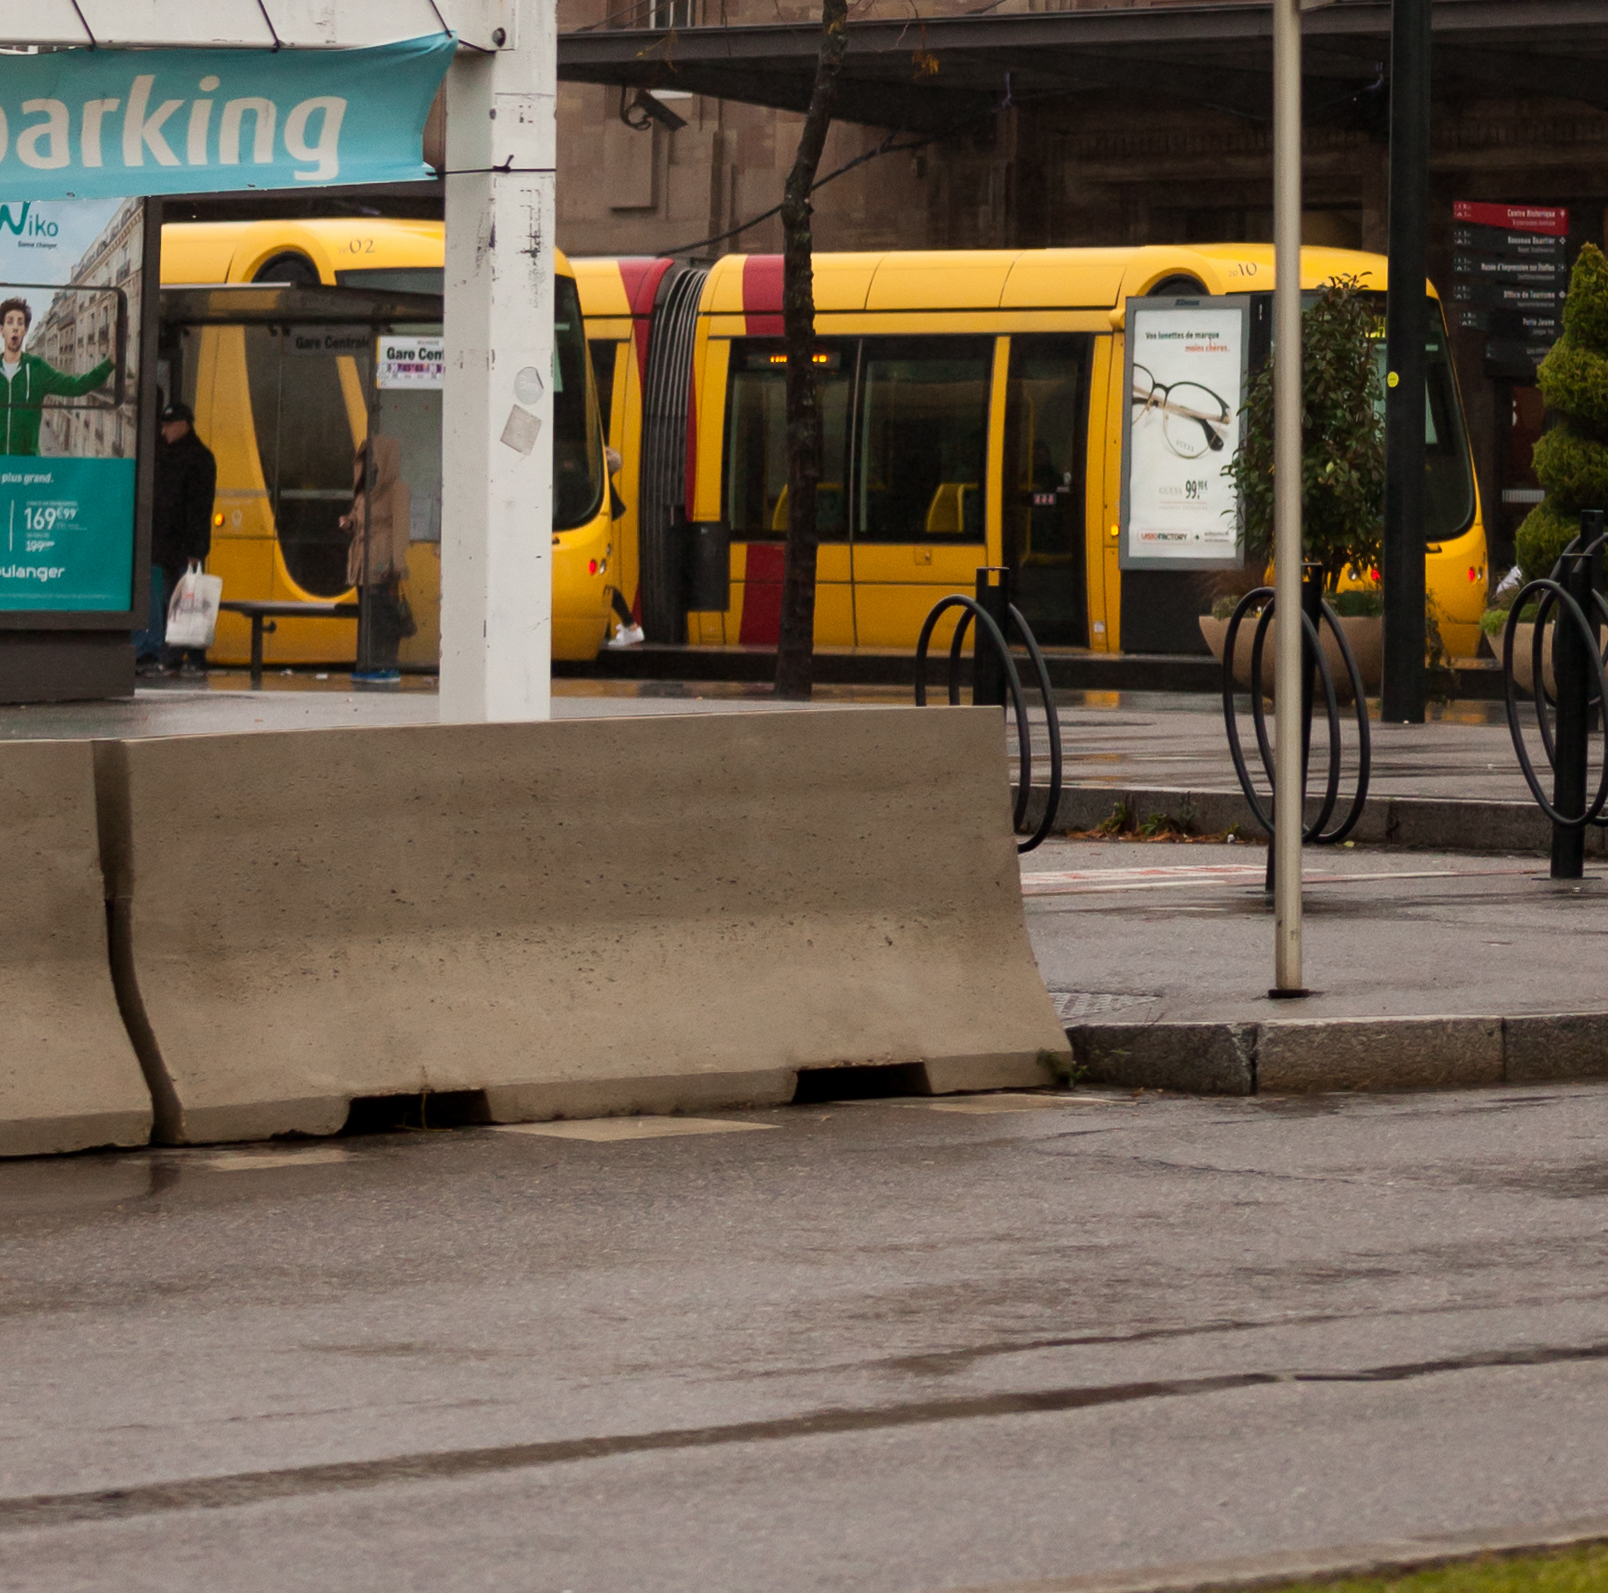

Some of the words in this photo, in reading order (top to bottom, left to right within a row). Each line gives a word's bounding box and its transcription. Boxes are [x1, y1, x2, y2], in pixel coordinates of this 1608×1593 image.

[0, 74, 347, 181] arking
[387, 346, 415, 361] Gare
[418, 346, 444, 361] Cen
